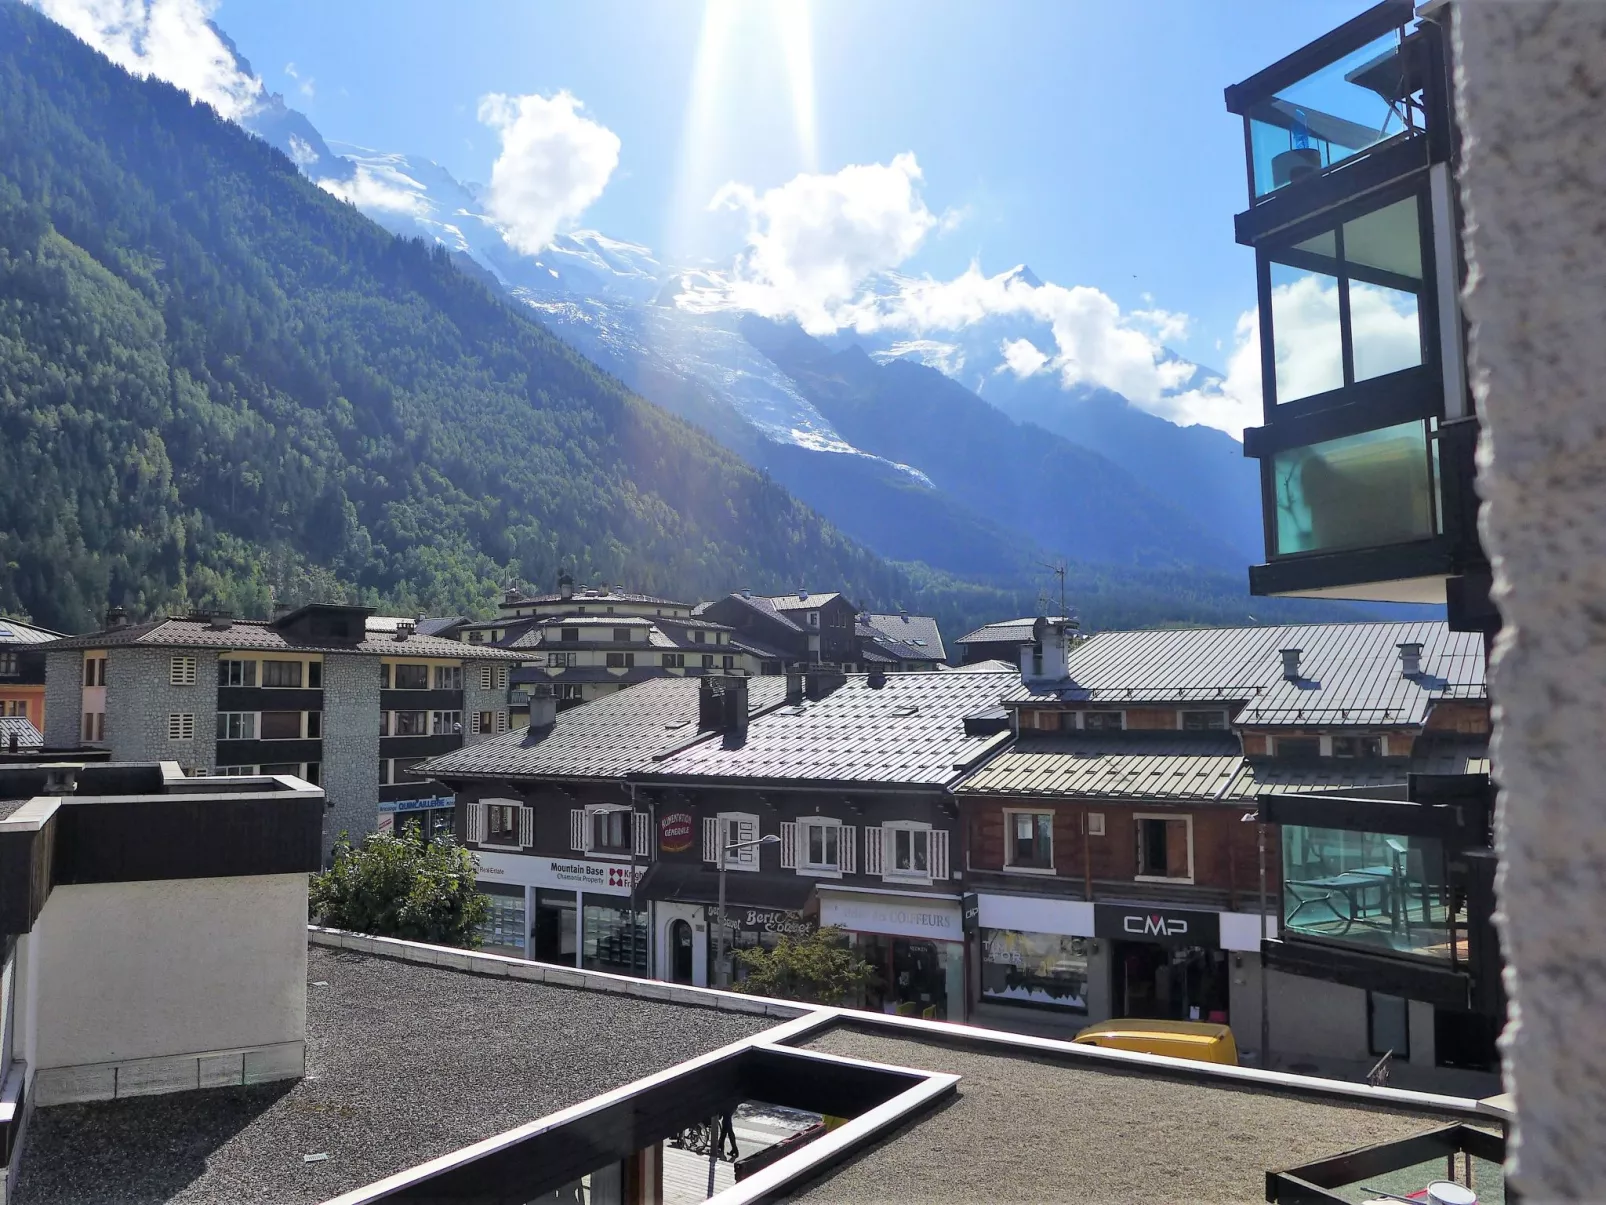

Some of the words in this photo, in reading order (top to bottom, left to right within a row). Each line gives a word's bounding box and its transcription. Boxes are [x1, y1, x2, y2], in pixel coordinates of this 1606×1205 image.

[398, 799, 445, 810] QUINCAILLERIE
[550, 862, 585, 875] Mountain
[586, 865, 604, 876] Base
[557, 873, 582, 881] Chamonix
[583, 875, 604, 886] Property
[888, 909, 950, 927] COIFFEURS
[1123, 914, 1188, 936] CMP
